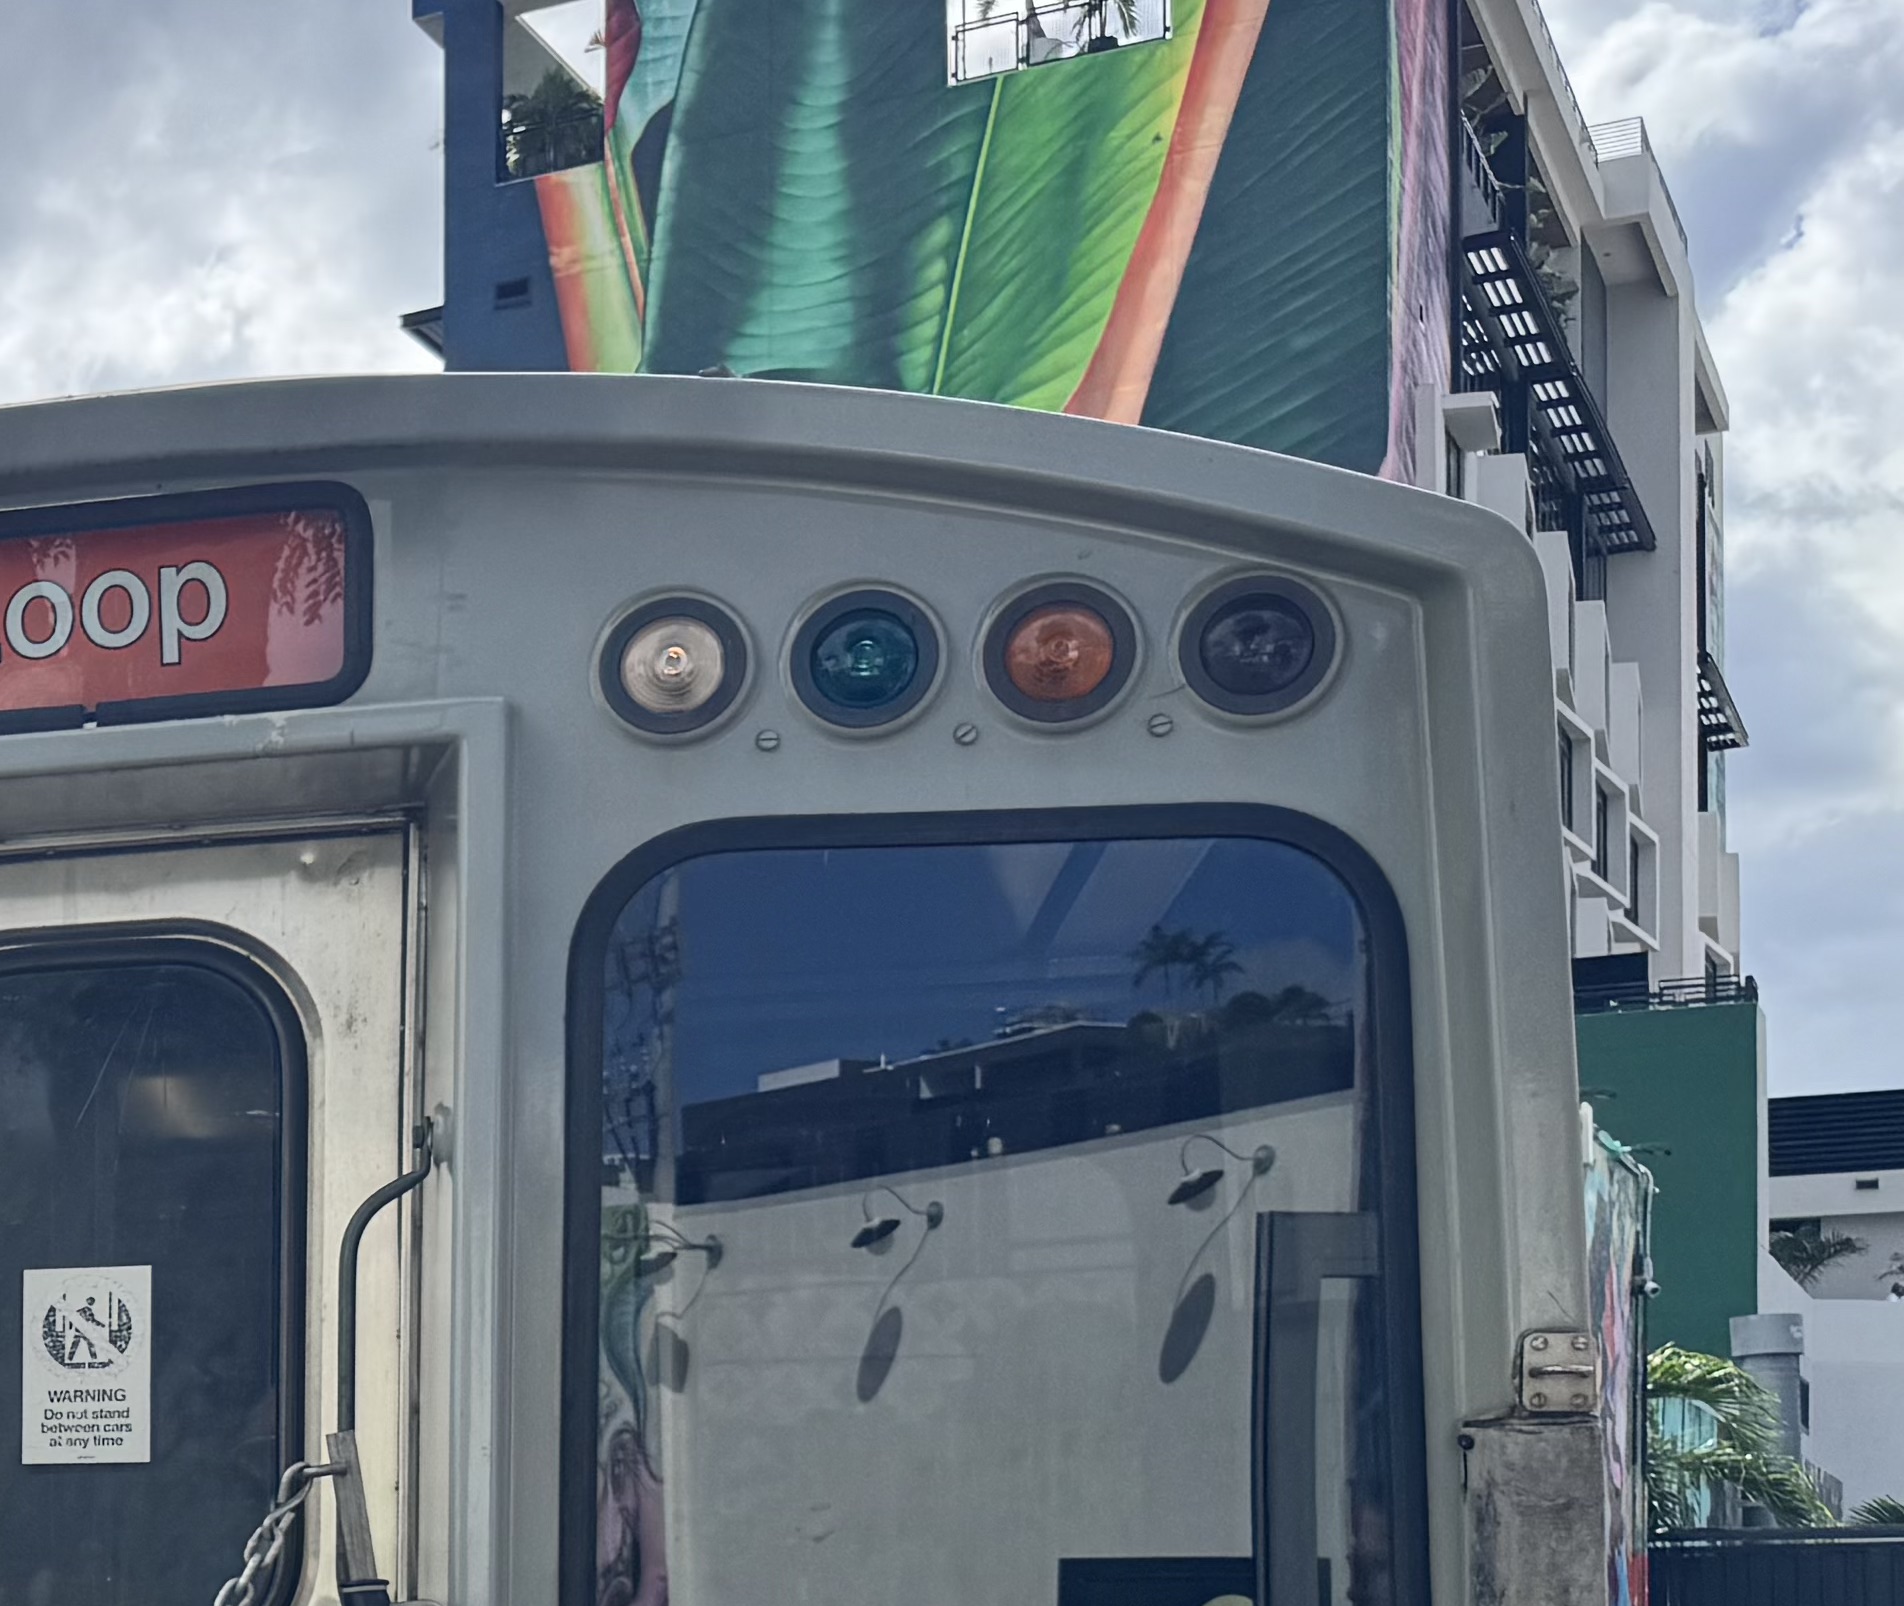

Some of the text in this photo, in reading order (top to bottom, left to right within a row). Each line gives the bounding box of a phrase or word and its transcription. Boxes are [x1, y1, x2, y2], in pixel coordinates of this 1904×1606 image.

[47, 1388, 126, 1403] WARNING
[44, 1407, 130, 1420] Do not stand
[41, 1422, 132, 1433] between cars
[49, 1435, 123, 1449] at any time
